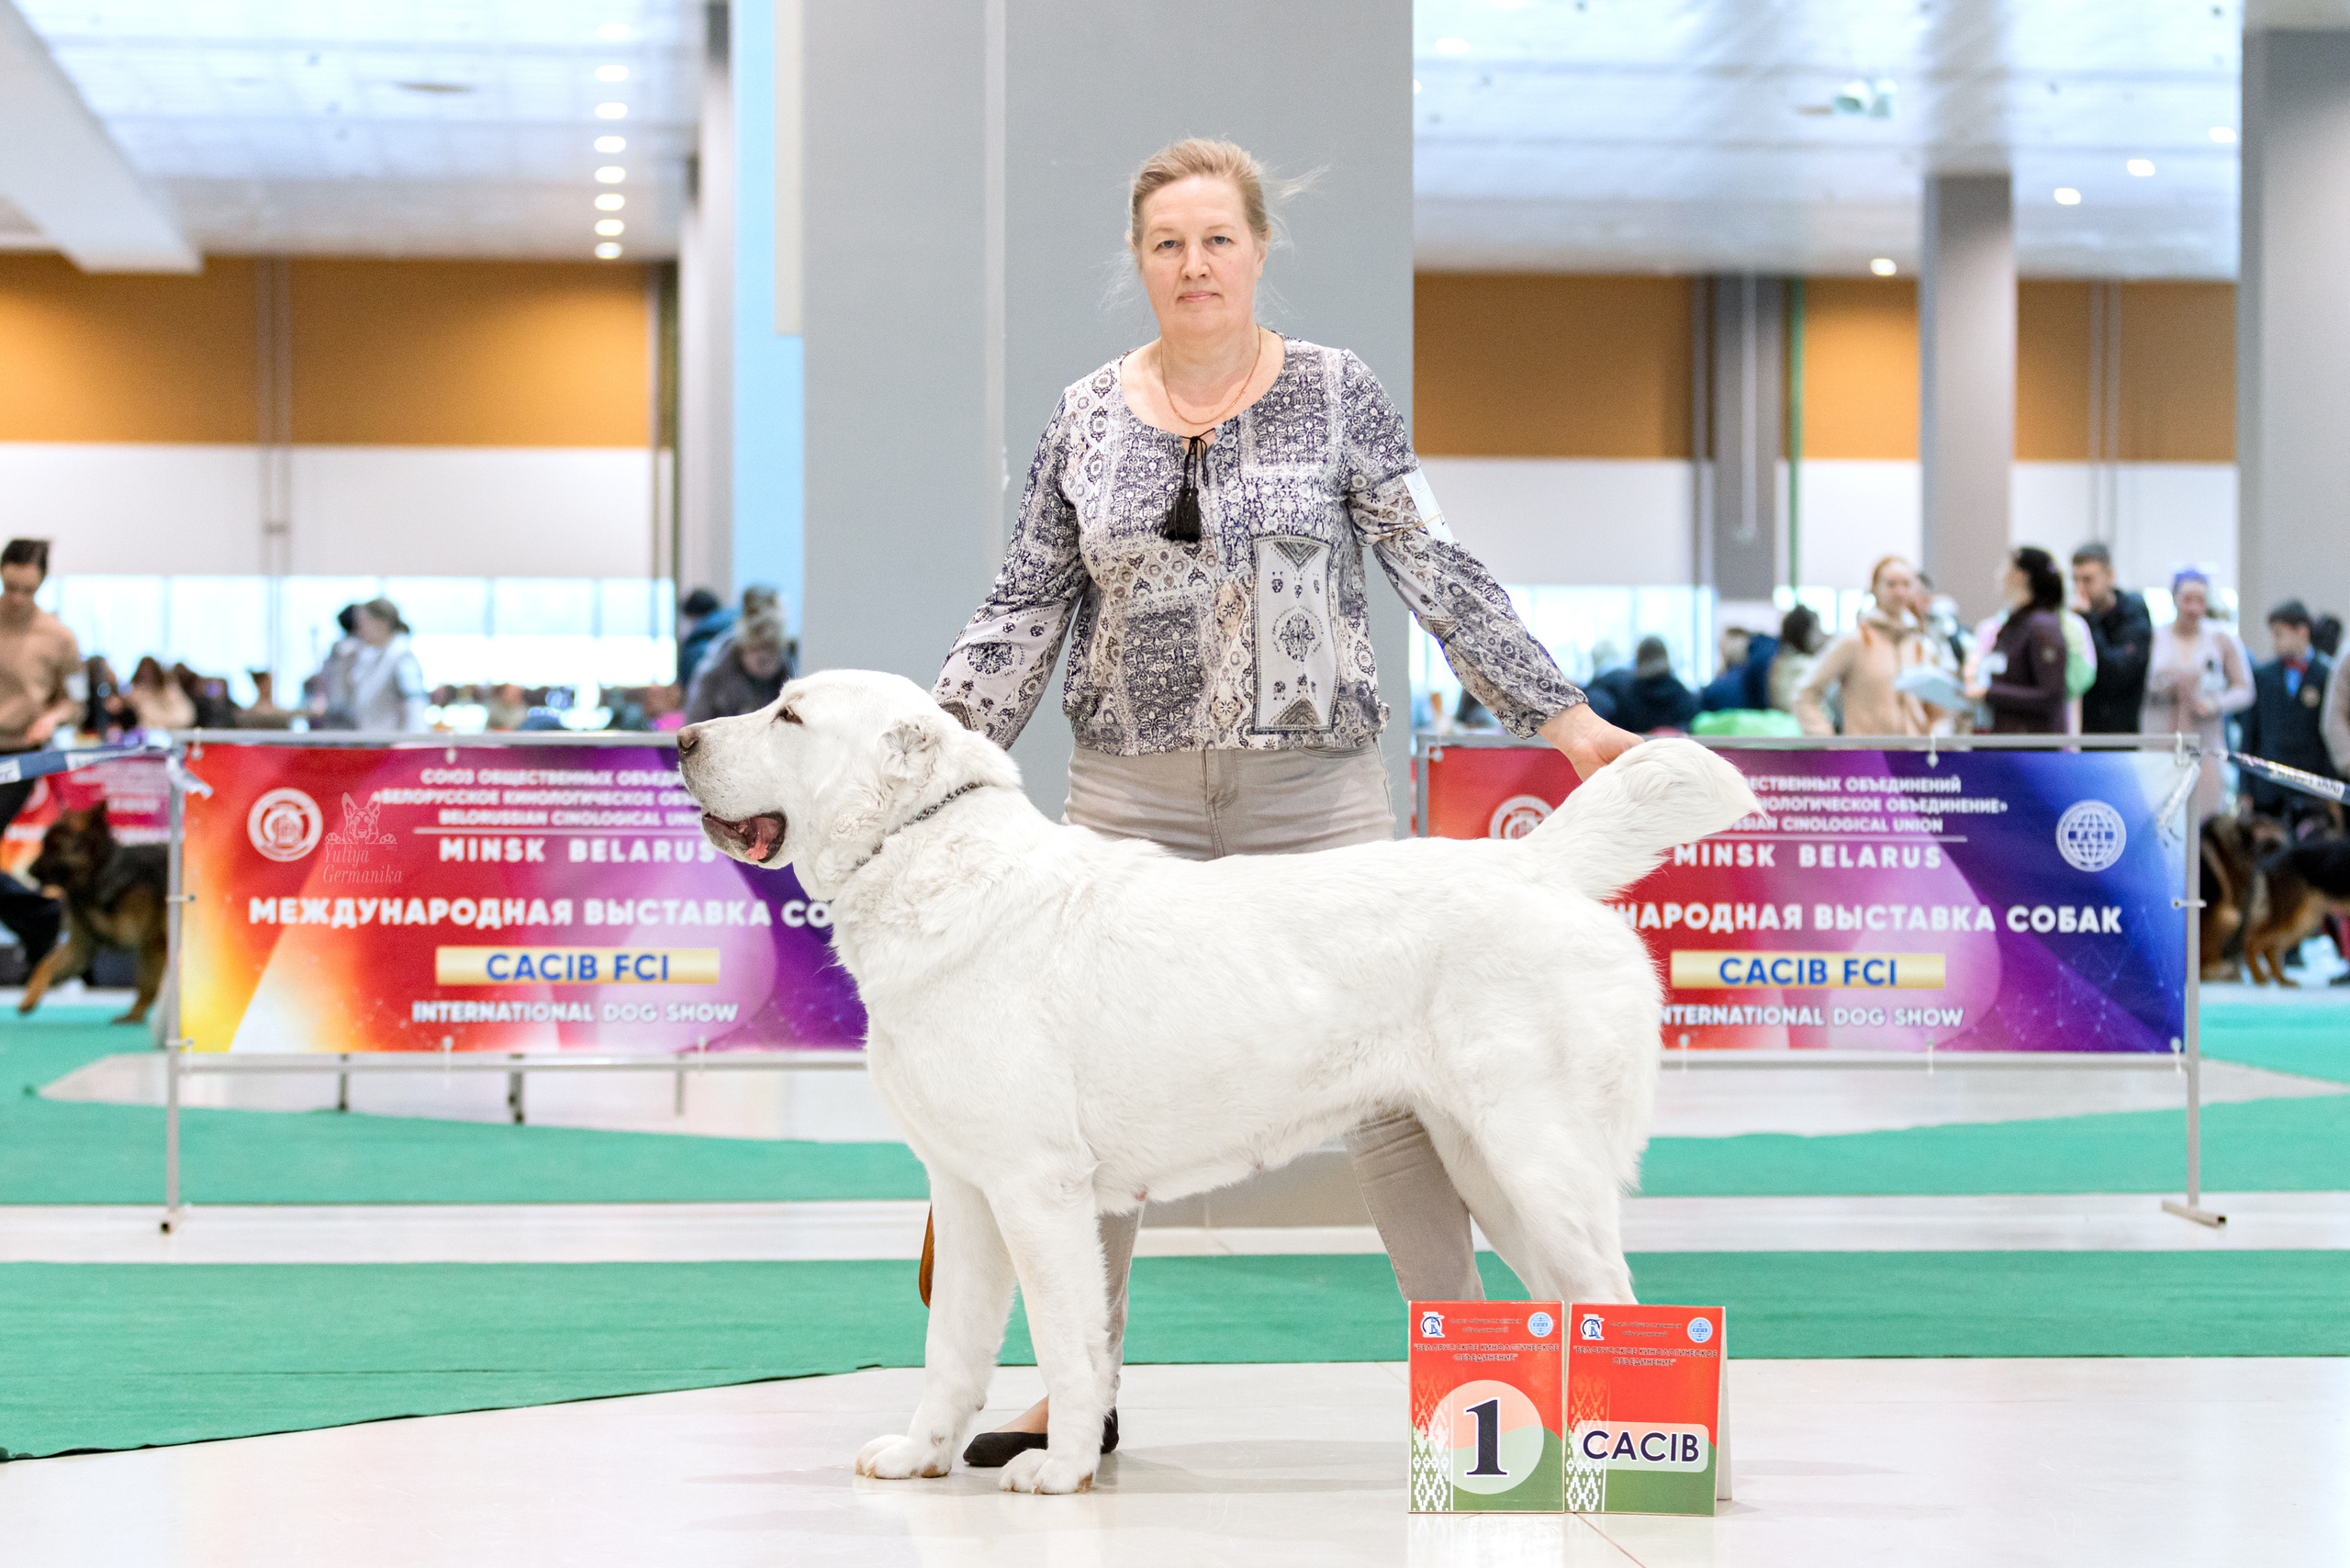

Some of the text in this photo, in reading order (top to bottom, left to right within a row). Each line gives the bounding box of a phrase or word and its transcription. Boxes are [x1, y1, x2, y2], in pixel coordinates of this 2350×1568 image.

[1844, 774, 1962, 793] ОБЪЕДИНЕНИЙ
[1757, 796, 1882, 813] НОЛОГИЧЕСКОЕ
[1781, 815, 1888, 832] CINOLOGICAL
[1893, 817, 1944, 833] UNION
[439, 837, 717, 864] MINSK BELARUS
[1673, 842, 1942, 868] MINSK BELARUS
[249, 896, 832, 930] МЕЖДУНАРОДНАЯ ВЫСТАВКА СО
[1613, 902, 2122, 934] НАРОДНАЯ ВЫСТАВКА СОБАК
[486, 953, 669, 982] CACIB FCI
[1718, 957, 1897, 986] CACIB FCI
[412, 1000, 740, 1024] INTERNATIONAL DOG SHOW
[1659, 1003, 1965, 1028] NTERNATIONAL DOG SHOW
[1481, 1343, 1560, 1352] КИНОЛОГИЧЕСКОЕ
[1639, 1348, 1718, 1358] КИНОЛОГИЧЕСКОЕ
[1464, 1397, 1509, 1477] 1
[1582, 1429, 1700, 1463] CACIB
